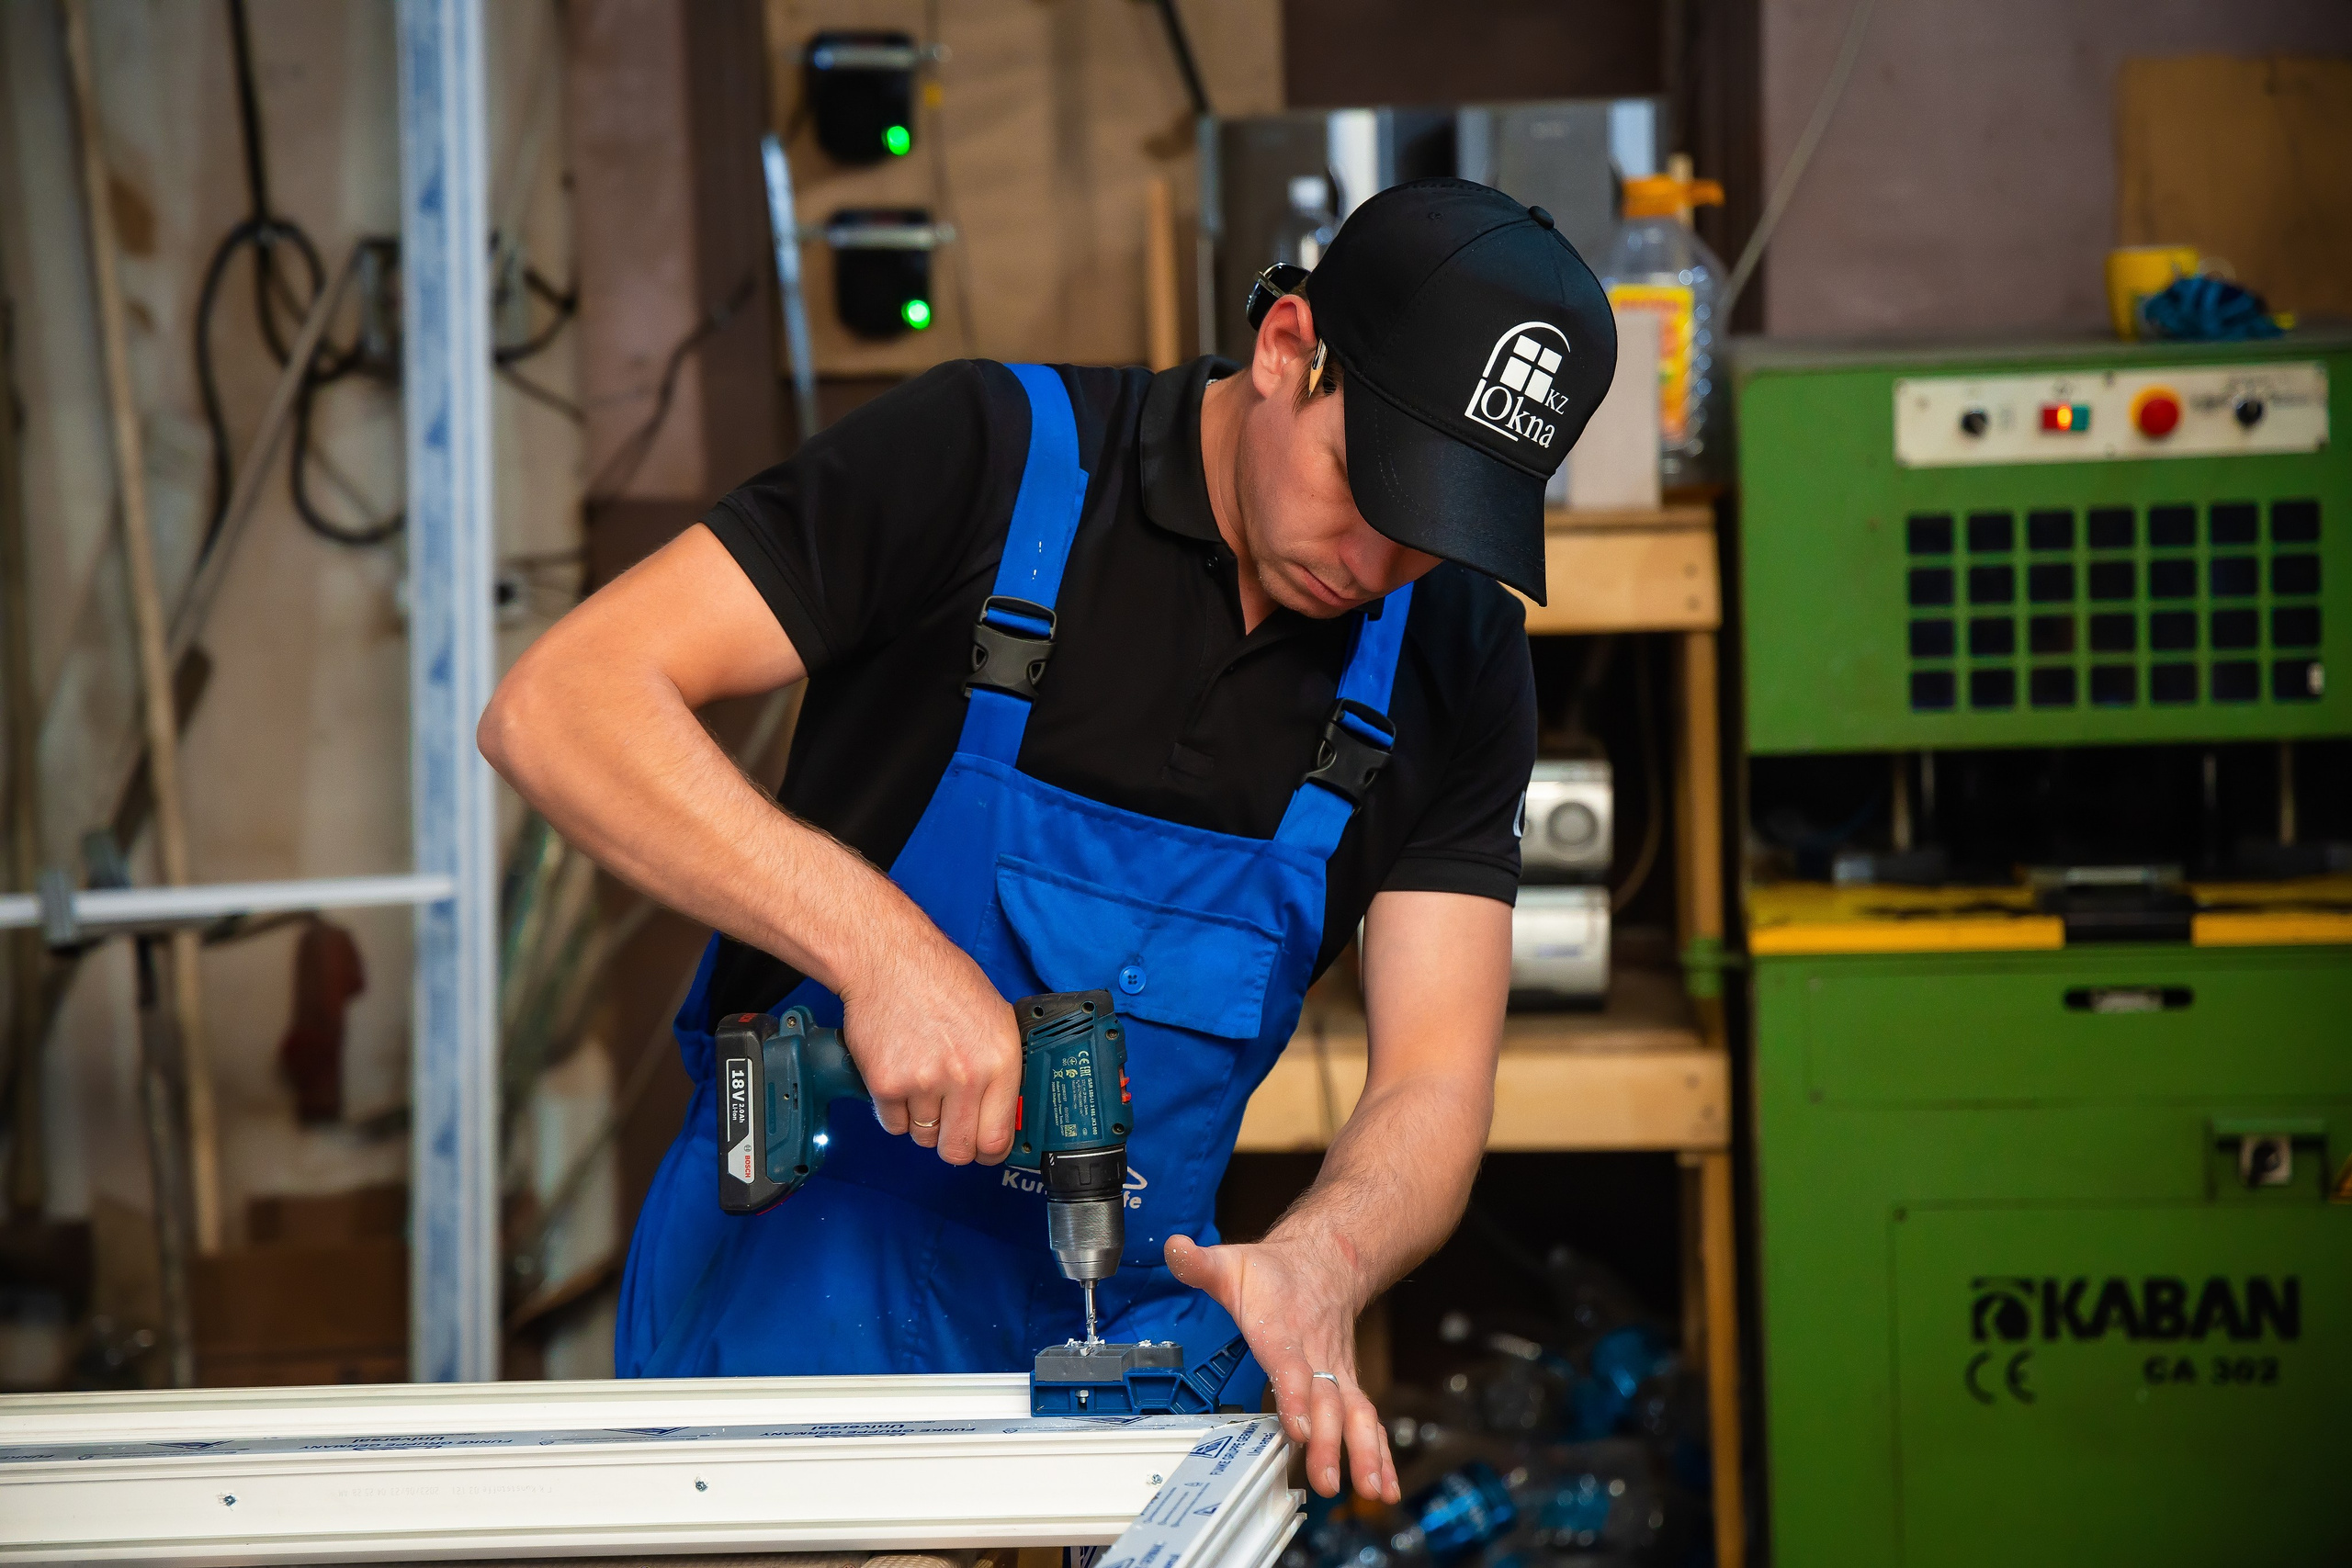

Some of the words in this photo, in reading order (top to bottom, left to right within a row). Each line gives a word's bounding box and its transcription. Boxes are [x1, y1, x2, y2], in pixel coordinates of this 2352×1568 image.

[1544, 389, 1569, 415] KZ
[1480, 386, 1555, 448] Okna
[731, 1070, 745, 1102] 18V
[2041, 1275, 2300, 1342] KABAN
[1236, 1422, 1261, 1442] GERMANY
[1247, 1432, 1277, 1457] Universal
